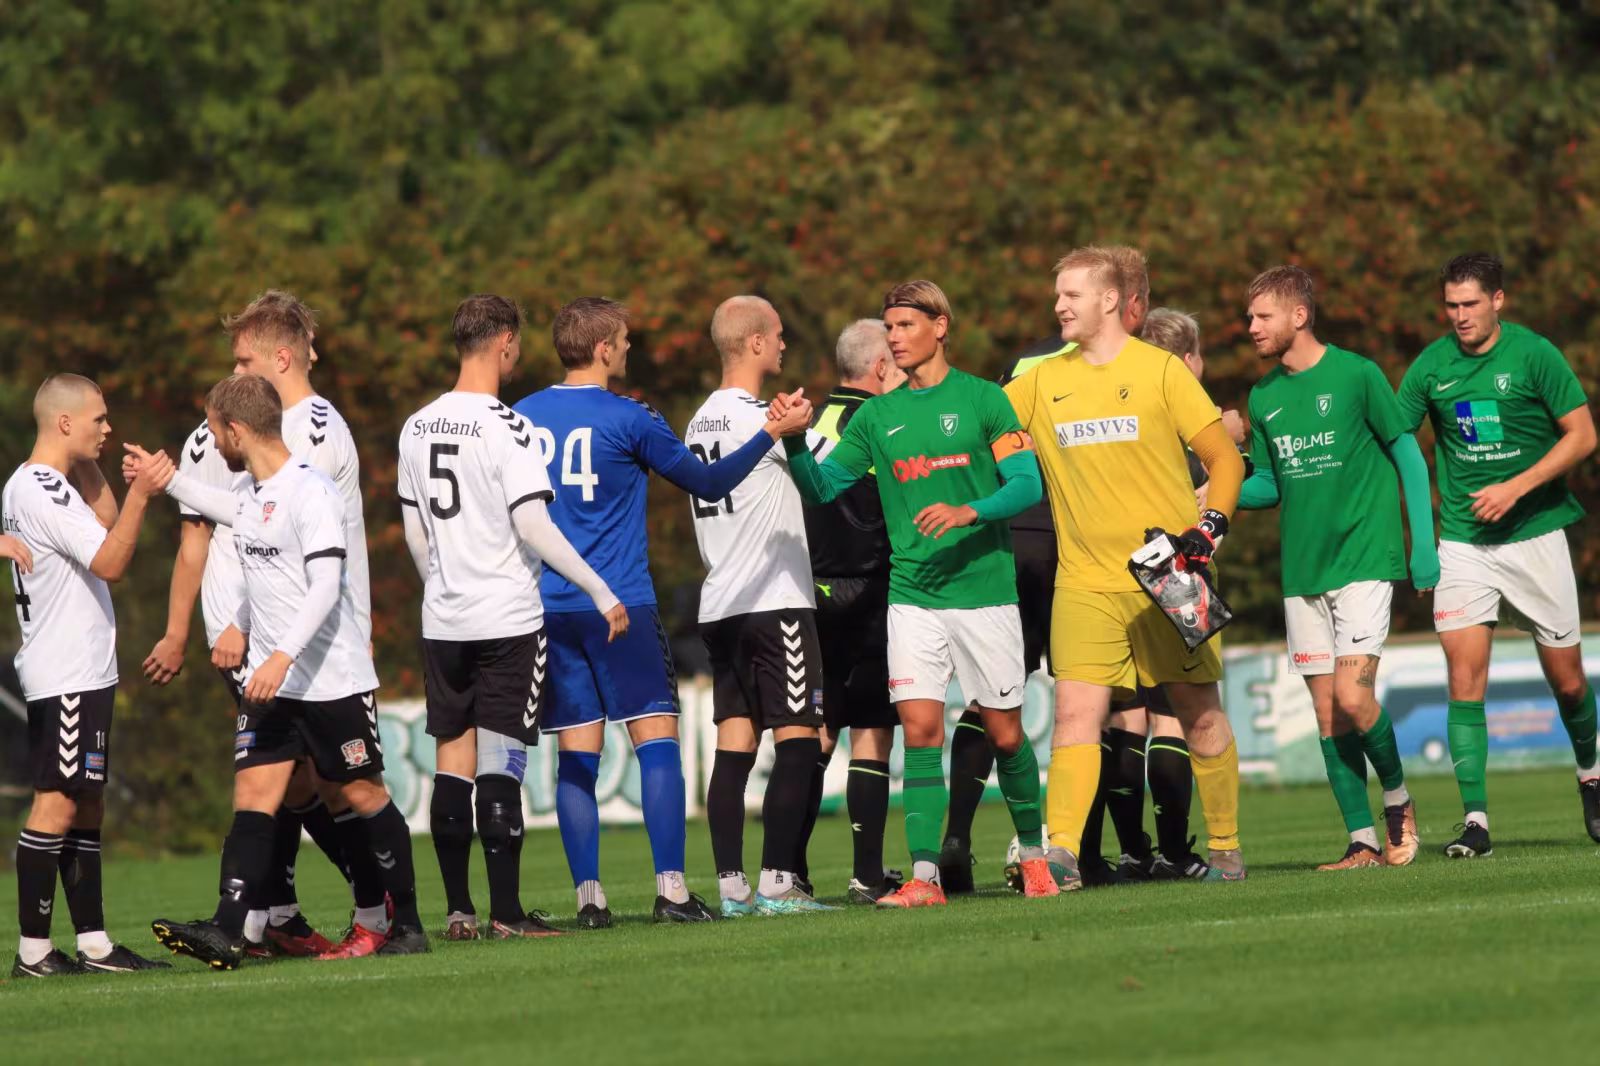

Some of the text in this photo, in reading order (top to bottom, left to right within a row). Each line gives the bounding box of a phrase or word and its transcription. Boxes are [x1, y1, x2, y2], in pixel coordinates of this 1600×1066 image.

[413, 418, 483, 438] Sydbank
[1273, 431, 1335, 458] HOLME
[1468, 444, 1494, 452] Aarhus
[1486, 448, 1520, 460] Brabrand
[893, 454, 931, 483] OK
[1309, 454, 1333, 463] service
[429, 443, 461, 520] 5
